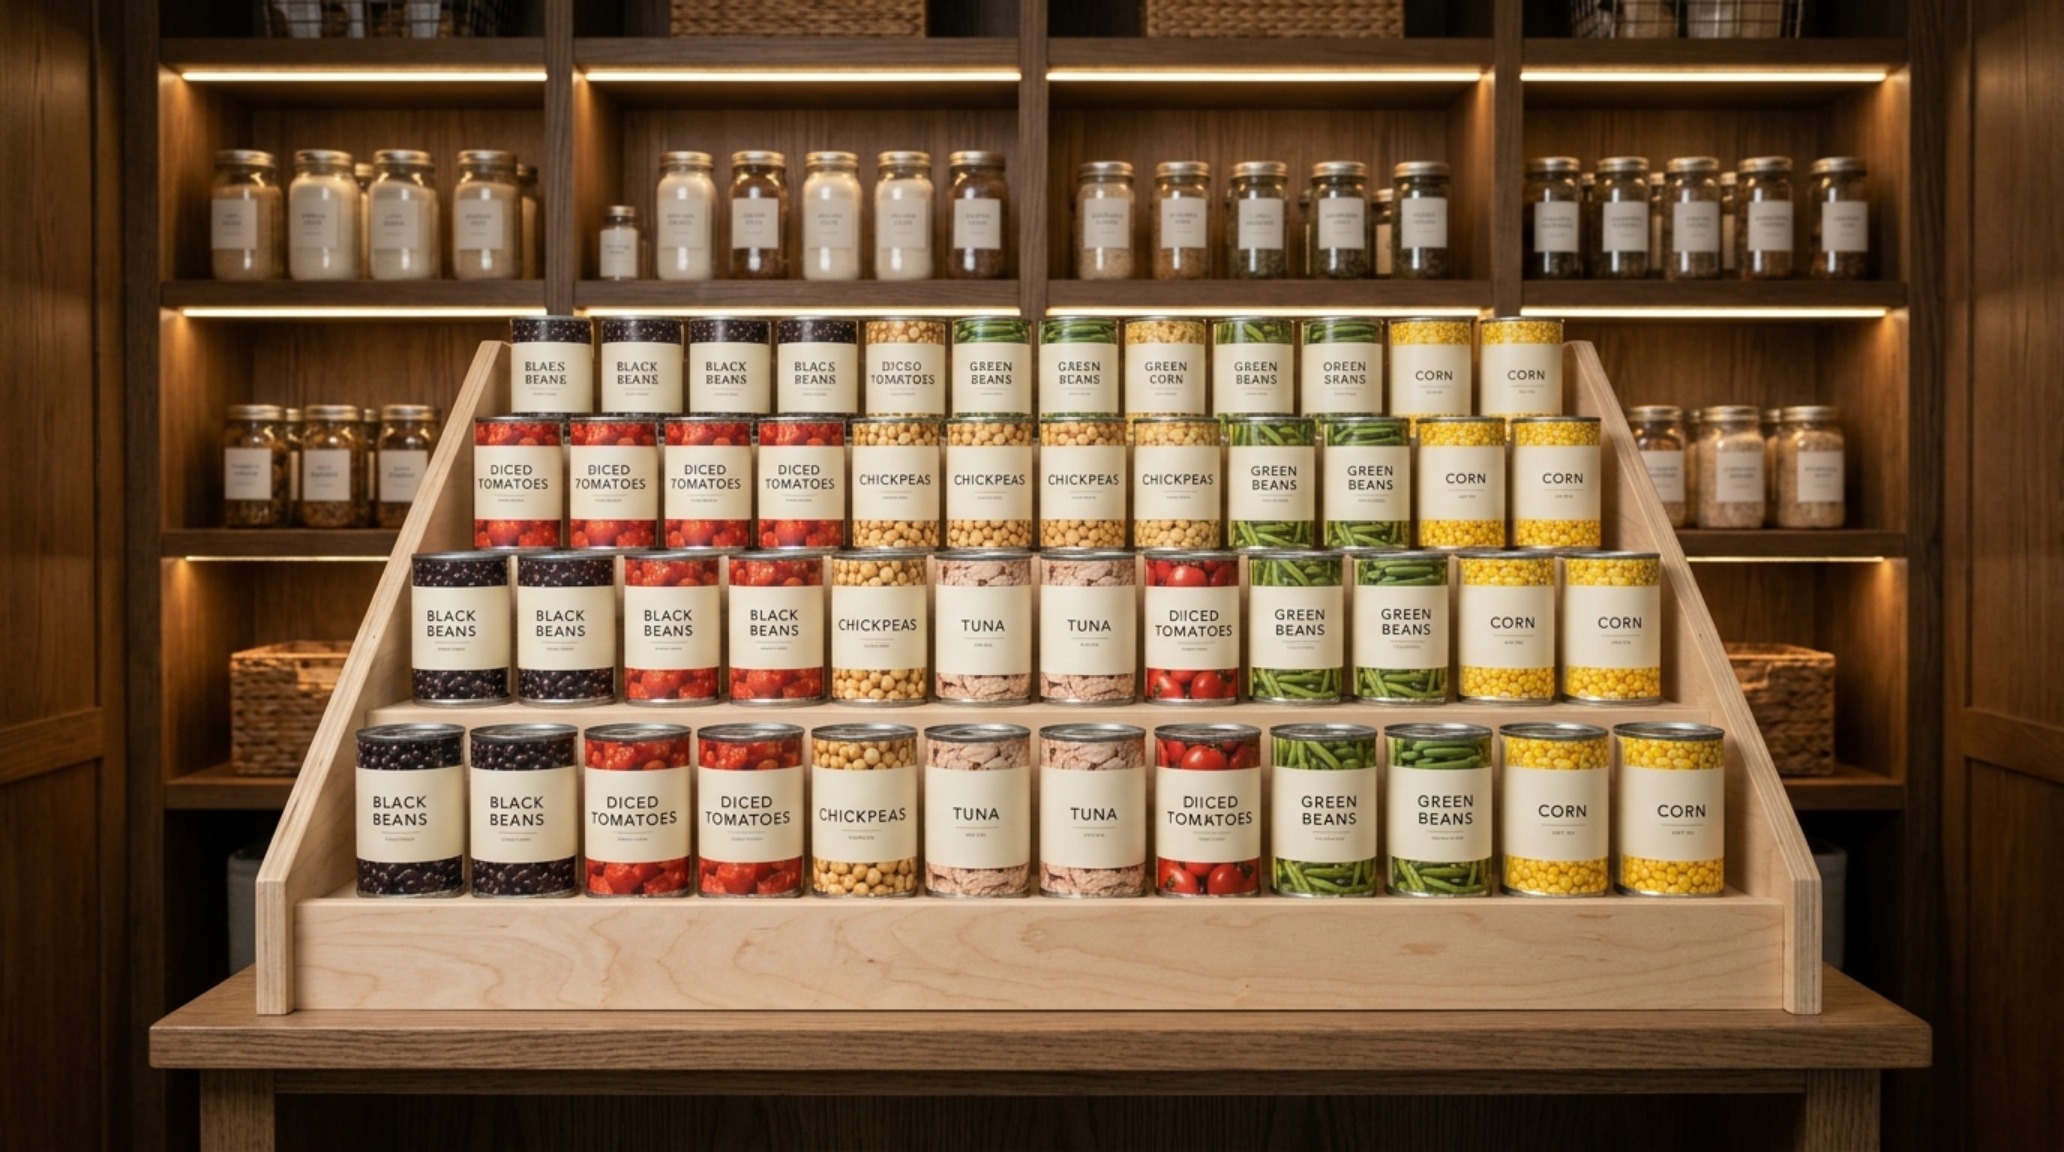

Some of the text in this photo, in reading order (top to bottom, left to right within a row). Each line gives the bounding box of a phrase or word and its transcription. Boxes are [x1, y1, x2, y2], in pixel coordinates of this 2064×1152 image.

[1144, 360, 1188, 372] GREEN
[1233, 360, 1278, 372] GREEN
[705, 374, 748, 385] BEANS
[1149, 373, 1184, 385] CORN
[1235, 374, 1278, 385] BEANS
[1415, 369, 1453, 382] CORN
[1507, 369, 1545, 381] CORN
[490, 464, 534, 477] DICED
[684, 464, 727, 476] DICED
[777, 464, 820, 476] DICED
[1250, 465, 1297, 477] GREEN
[1346, 465, 1394, 477] GREEN
[478, 477, 549, 490] TOMATOES
[765, 477, 835, 490] TOMATOES
[858, 473, 932, 486] CHICKPEAS
[953, 473, 1026, 486] CHICKPEAS
[1047, 473, 1120, 486] CHICKPEAS
[1142, 473, 1214, 486] CHICKPEAS
[1251, 479, 1297, 491] BEANS
[1347, 479, 1394, 491] BEANS
[1445, 472, 1486, 485] CORN
[1541, 472, 1584, 485] CORN
[426, 609, 477, 623] BLACK
[535, 609, 585, 622] BLACK
[643, 609, 693, 622] BLACK
[749, 608, 799, 622] BLACK
[1169, 609, 1220, 623] DIICED
[1274, 608, 1325, 622] GREEN
[1380, 607, 1432, 621] GREEN
[837, 618, 918, 633] CHICKPEAS
[960, 618, 1006, 633] TUNA
[1067, 618, 1112, 633] TUNA
[1381, 623, 1431, 636] BEANS
[1490, 615, 1536, 630] CORN
[1597, 615, 1642, 630] CORN
[426, 624, 477, 638] BEANS
[535, 624, 586, 638] BEANS
[644, 624, 694, 637] BEANS
[749, 624, 799, 637] BEANS
[1154, 624, 1233, 638] TOMATOES
[1275, 623, 1326, 637] BEANS
[372, 795, 427, 810] BLACK
[489, 795, 544, 810] BLACK
[606, 795, 660, 810] DICED
[720, 795, 773, 810] DICED
[1183, 795, 1239, 810] DIICED
[1301, 794, 1357, 810] GREEN
[1417, 794, 1474, 809] GREEN
[818, 807, 907, 824] CHICKPEAS
[952, 806, 1000, 822] TUNA
[1069, 806, 1118, 822] TUNA
[1538, 803, 1587, 819] CORN
[1656, 803, 1706, 819] CORN
[372, 812, 428, 827] BEANS
[489, 812, 545, 827] BEANS
[591, 810, 678, 827] TOMATOES
[705, 810, 791, 827] TOMATOES
[1301, 812, 1357, 826] BEANS
[1418, 811, 1474, 826] BEANS
